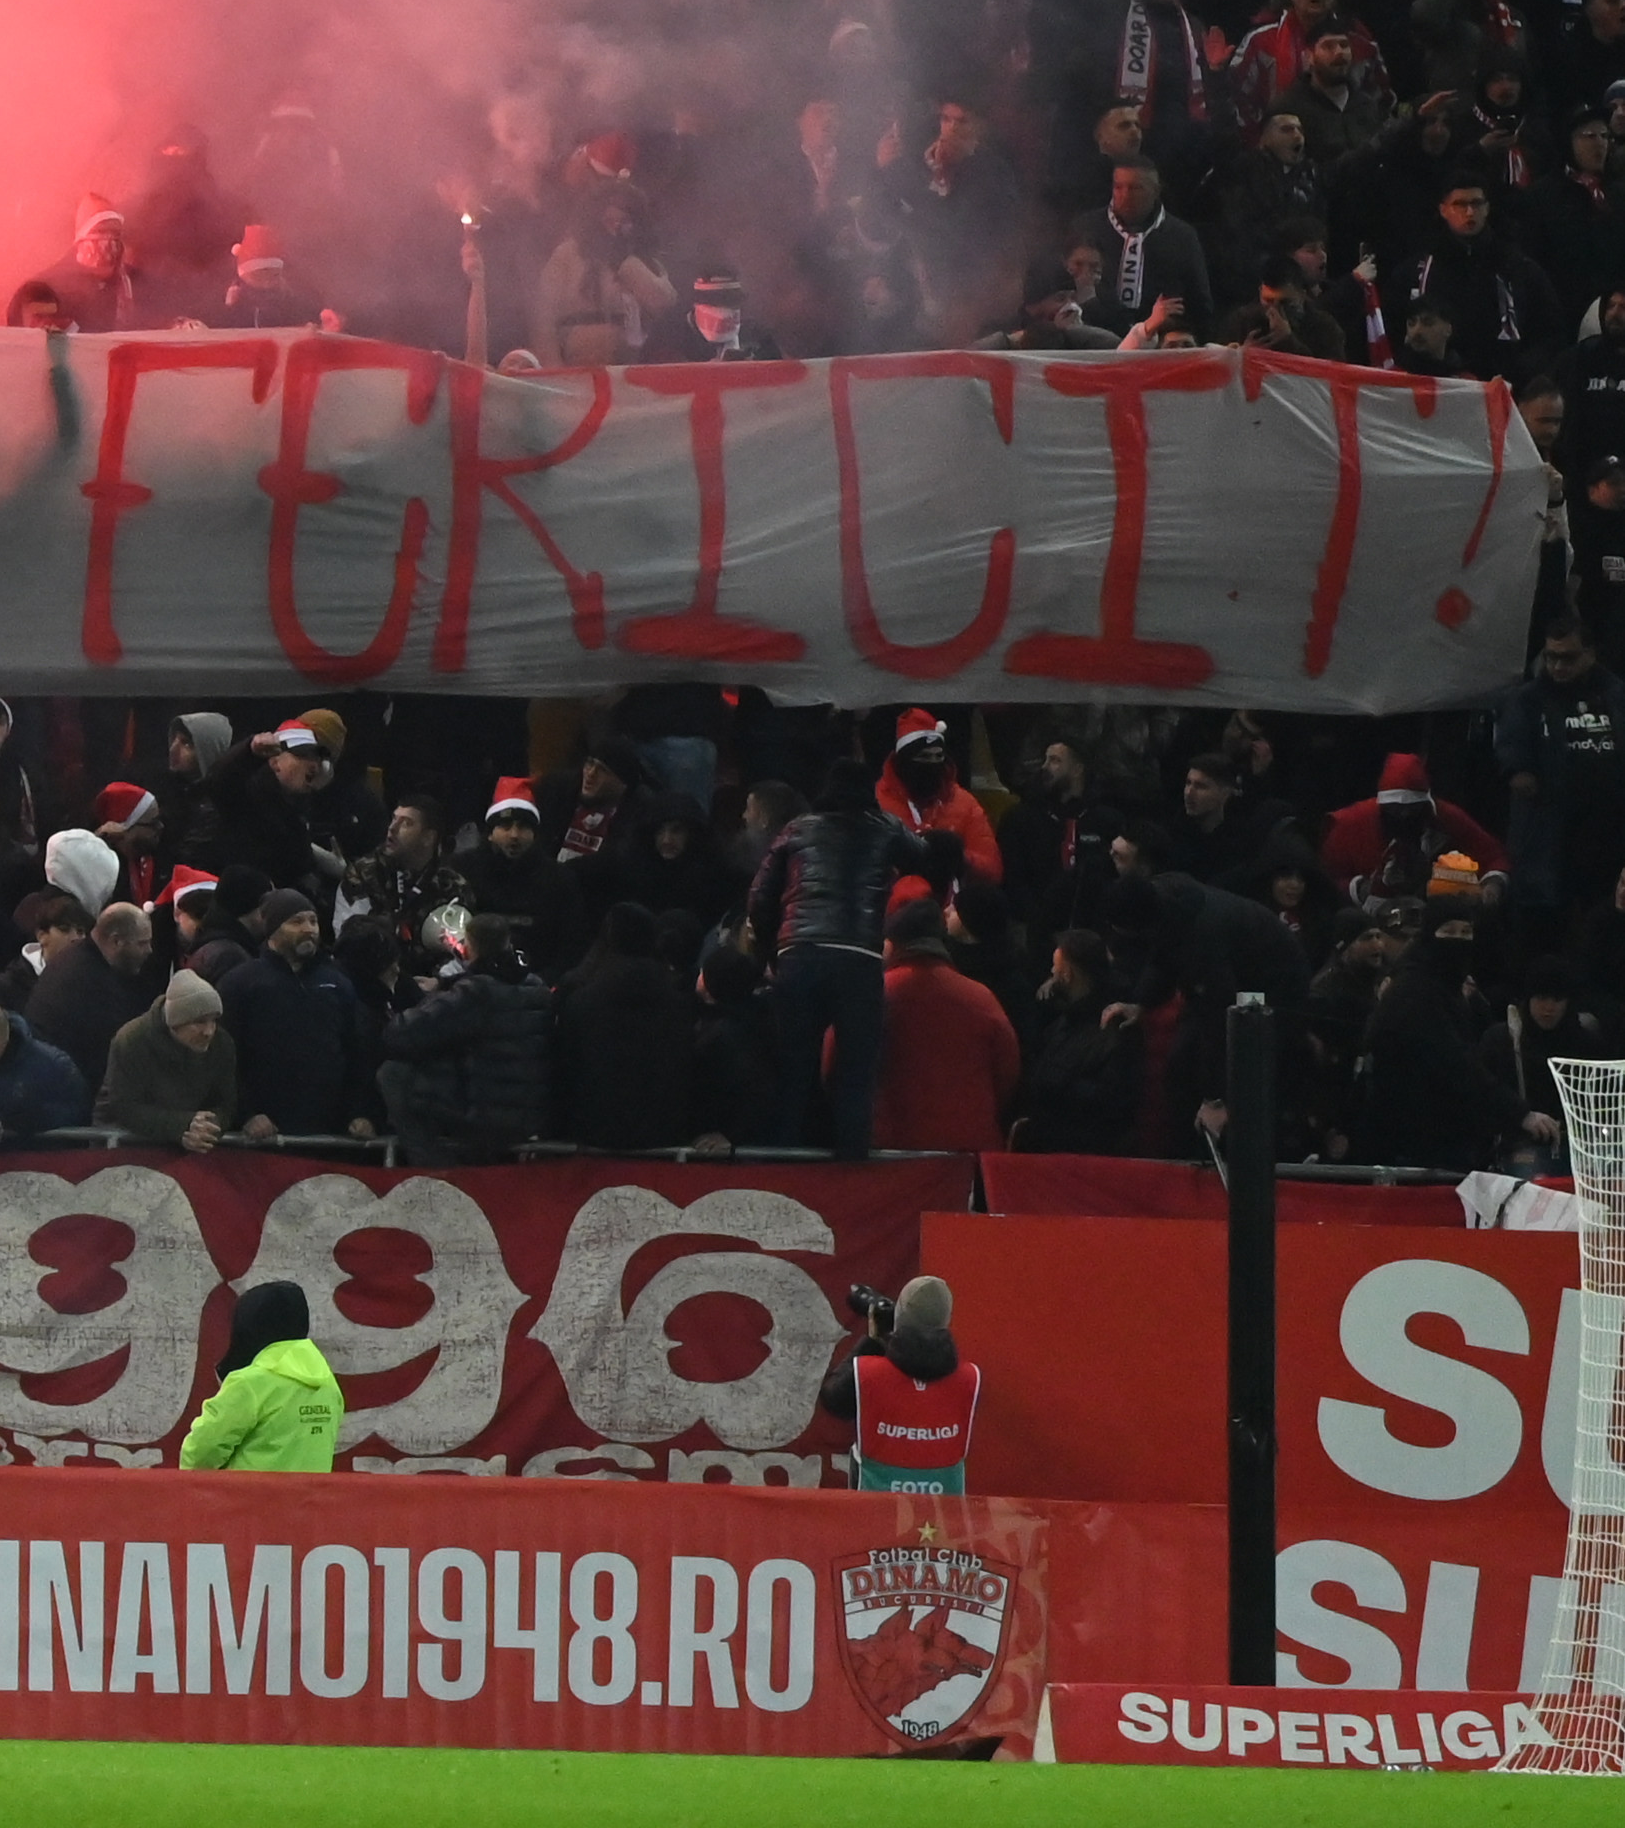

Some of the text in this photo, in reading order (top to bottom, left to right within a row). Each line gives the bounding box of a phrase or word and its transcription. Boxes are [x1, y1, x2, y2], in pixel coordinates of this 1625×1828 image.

[76, 330, 1512, 688] FERICIT!
[877, 1421, 959, 1441] SUPERLIGA
[890, 1480, 944, 1495] FOTO
[868, 1548, 983, 1570] Fotbal Club
[846, 1562, 1004, 1605] DINAMO
[903, 1720, 940, 1740] 1948
[1118, 1691, 1557, 1767] SUPERLIGA
